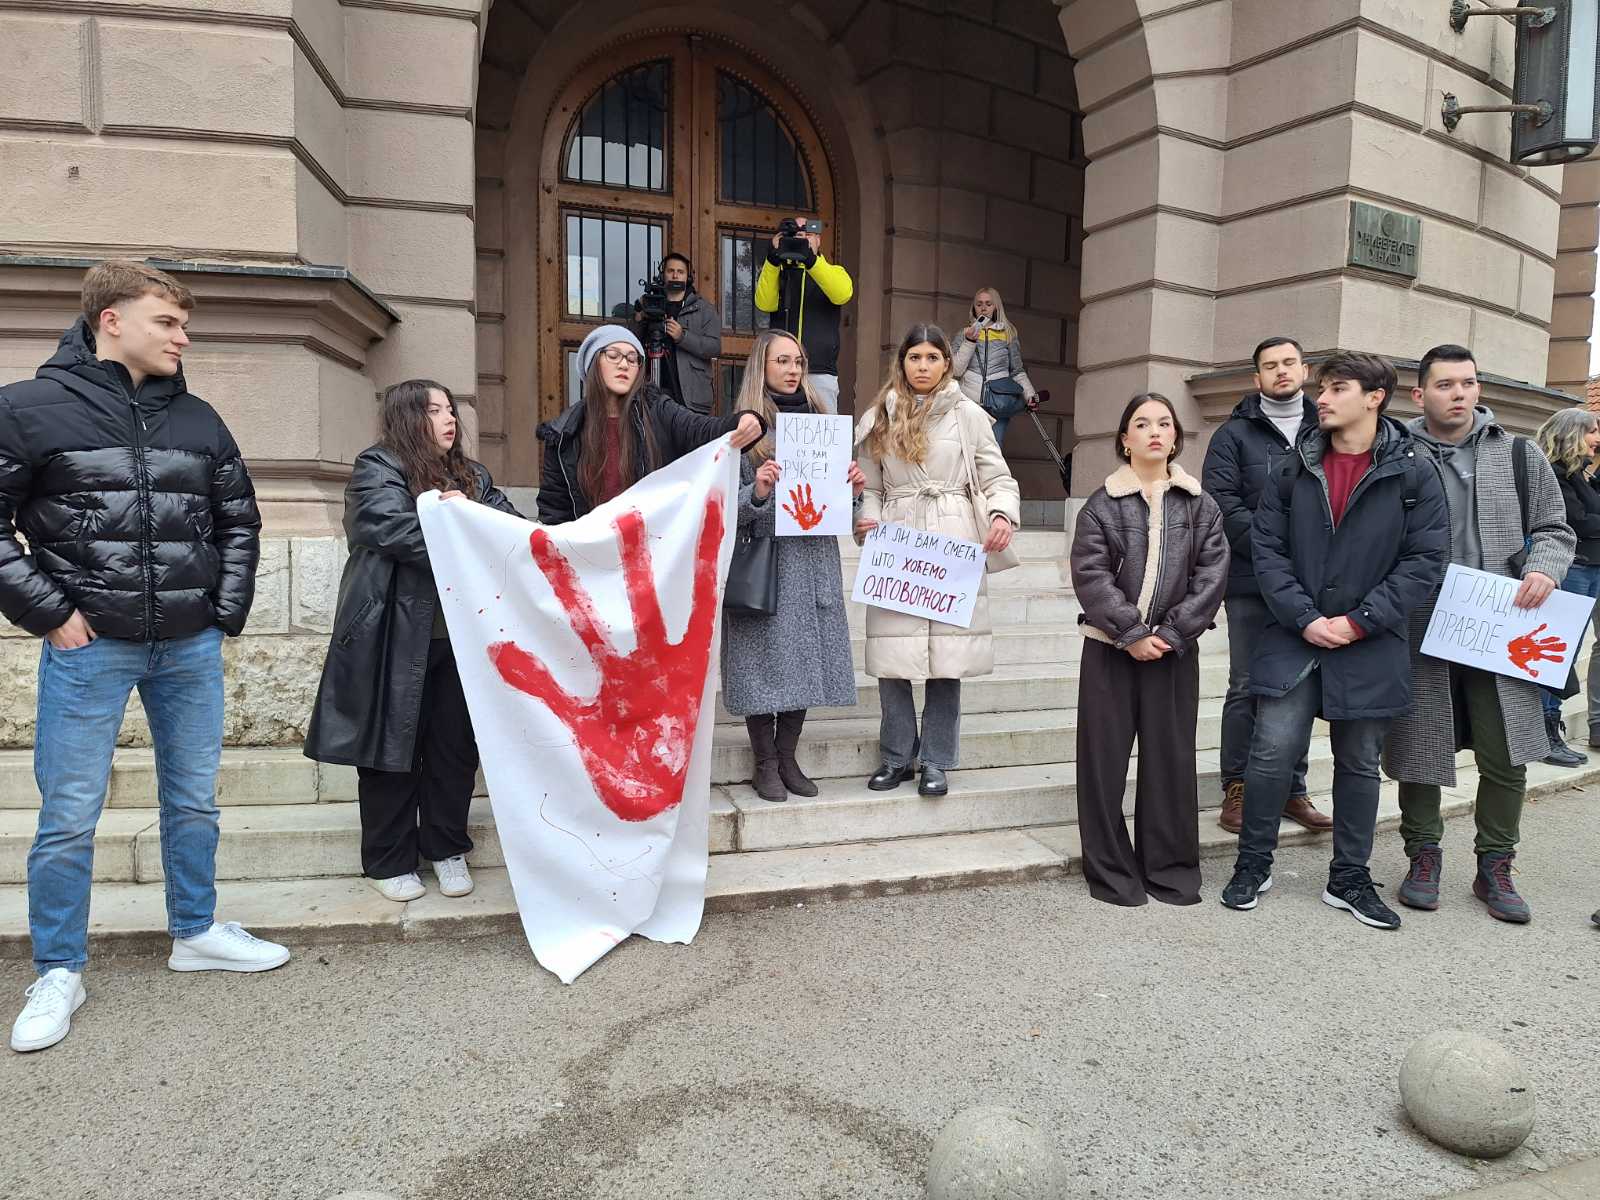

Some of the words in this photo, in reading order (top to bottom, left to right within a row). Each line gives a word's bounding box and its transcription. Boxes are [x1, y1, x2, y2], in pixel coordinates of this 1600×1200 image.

[783, 416, 841, 448] КРВАВЕ
[782, 459, 828, 480] РУКЕ!
[869, 524, 888, 541] ДА
[892, 528, 911, 545] ЛИ
[914, 533, 939, 551] ВАМ
[943, 540, 977, 562] СМЕТА
[871, 551, 895, 569] ШТО
[901, 557, 948, 580] ХОЋЕМО
[863, 574, 968, 614] ОДГОВОРНОСТ?
[1449, 572, 1540, 620] ГЛАД
[1427, 609, 1505, 657] ПРАВДЕ
